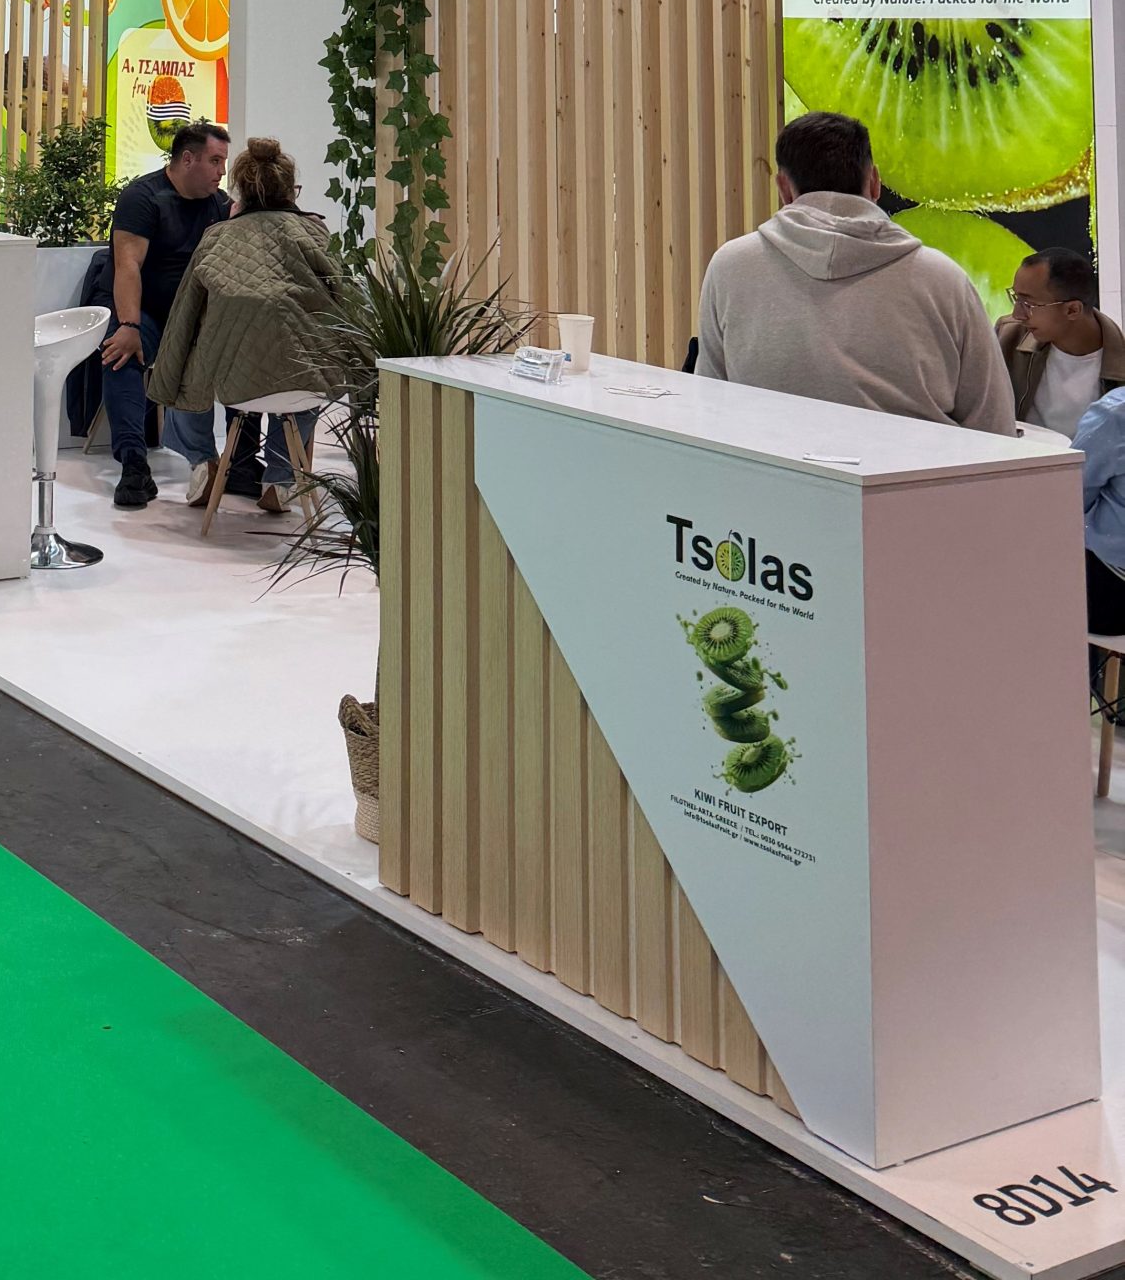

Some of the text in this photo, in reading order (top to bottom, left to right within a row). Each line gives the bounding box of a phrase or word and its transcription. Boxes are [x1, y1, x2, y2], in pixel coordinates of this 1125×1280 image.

[138, 59, 195, 77] ΤΣΑΜΠΑΣ
[666, 514, 814, 601] Tsolas
[675, 571, 814, 620] Created by Nature. Packed for the World
[694, 788, 787, 836] KIWI FRUIT EXPORT
[972, 1165, 1119, 1226] 8D14
